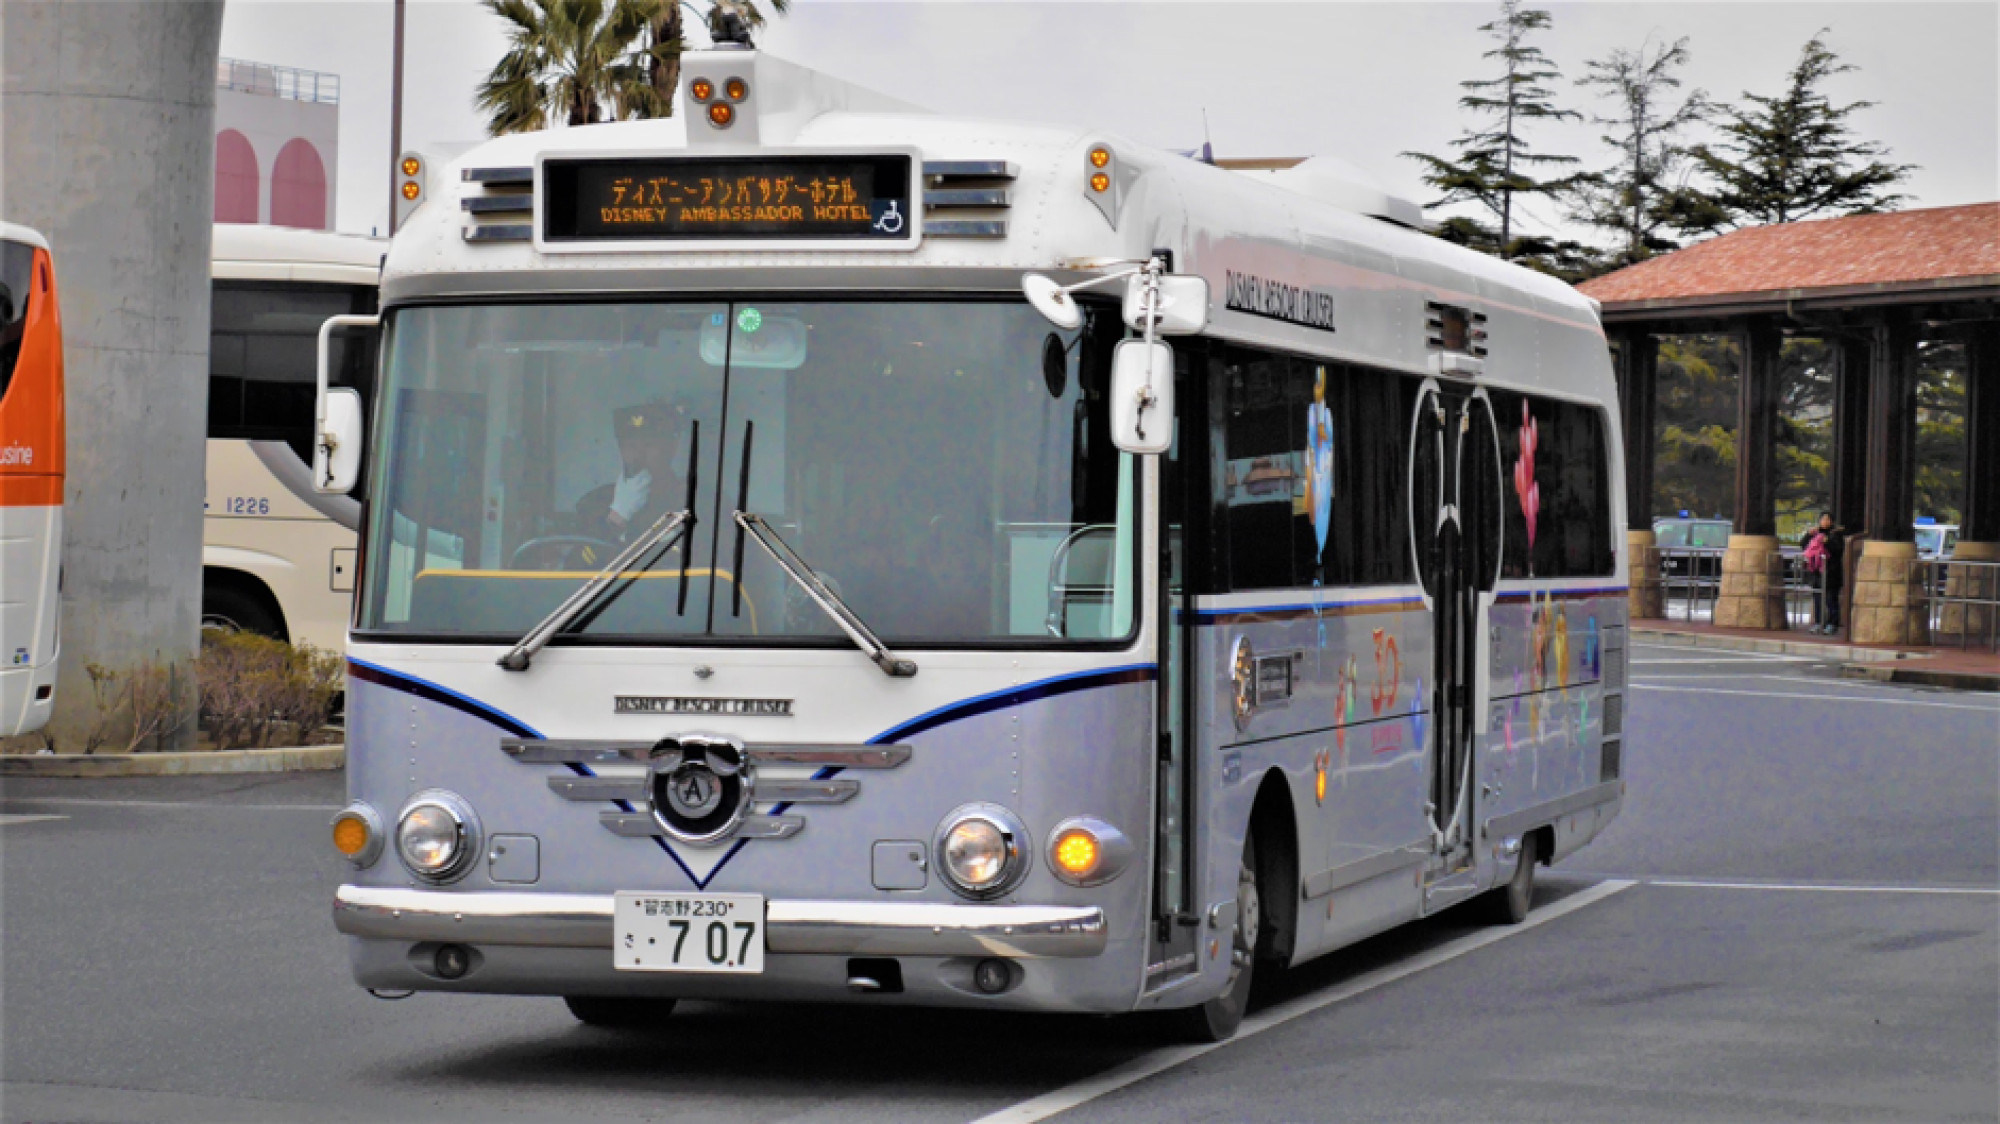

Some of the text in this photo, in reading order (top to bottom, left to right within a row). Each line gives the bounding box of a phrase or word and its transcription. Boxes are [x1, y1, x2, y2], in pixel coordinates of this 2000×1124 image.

[601, 204, 872, 223] DISNEY AMBASSADOR HOTEL
[226, 496, 270, 514] 1226
[615, 697, 792, 715] DISNEY RESORT CRUISER
[686, 776, 702, 802] A
